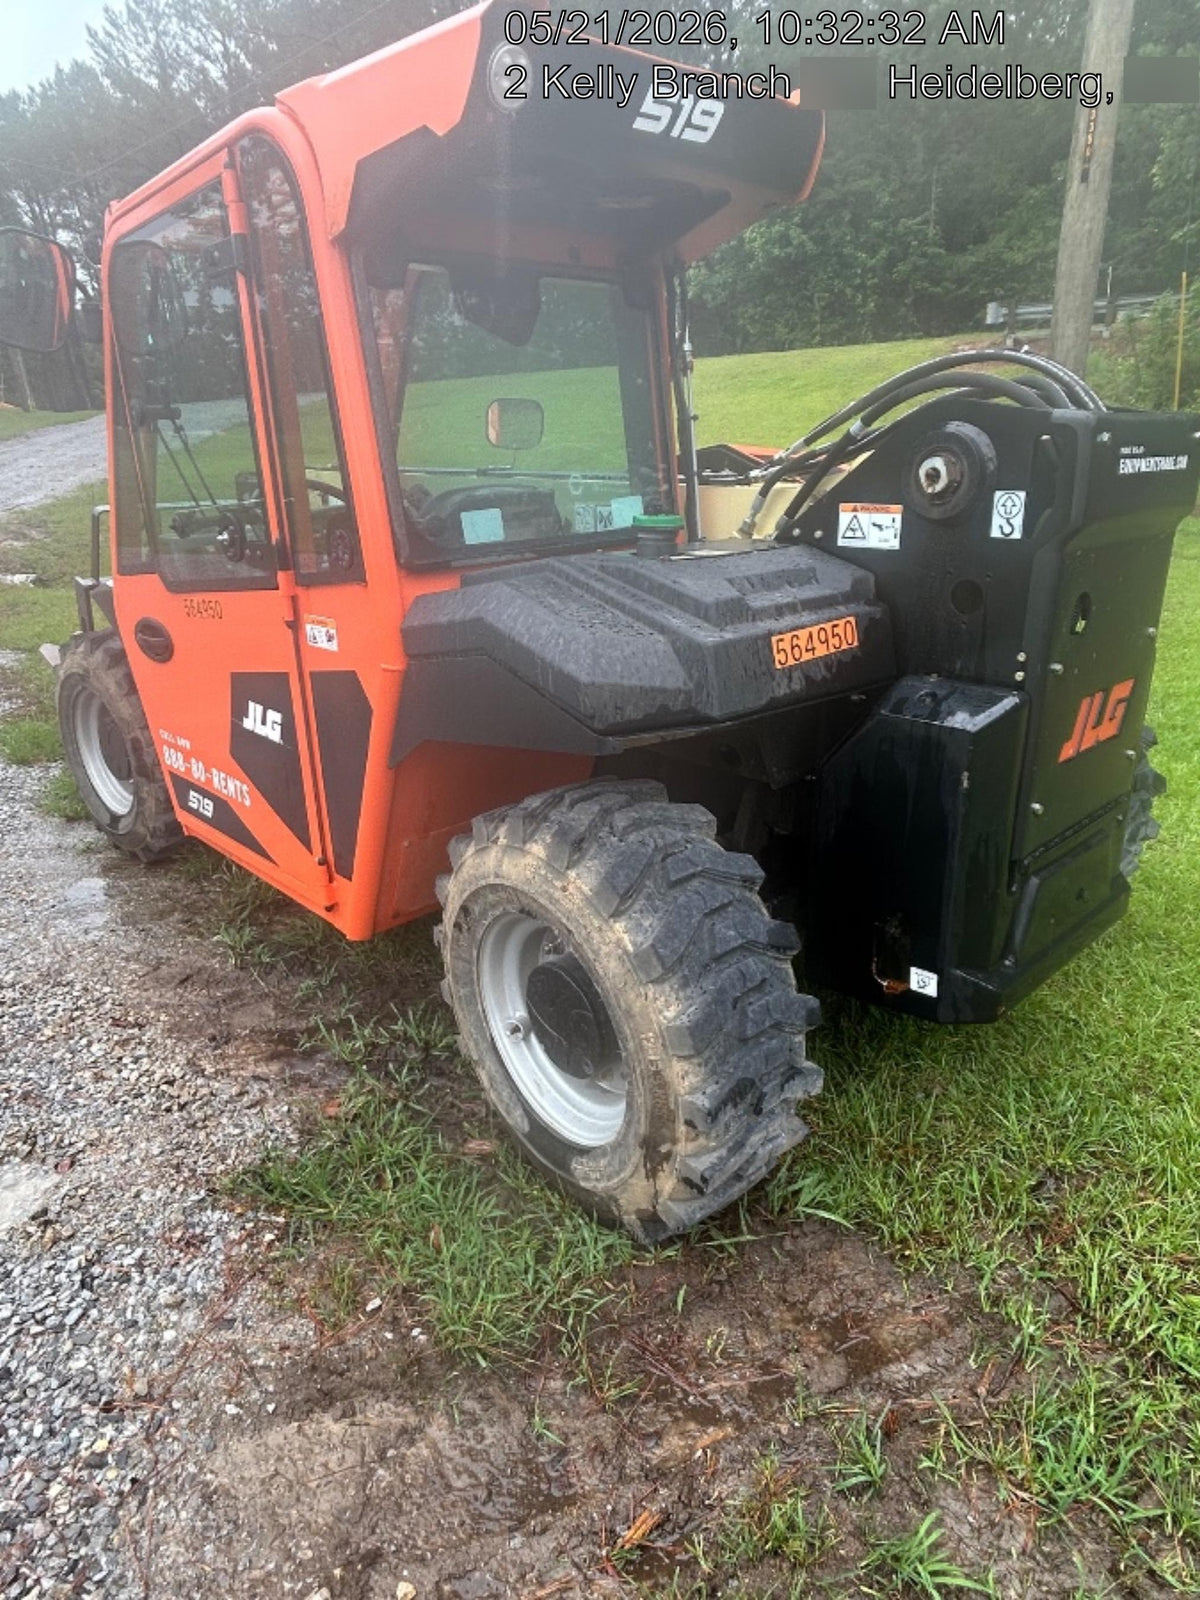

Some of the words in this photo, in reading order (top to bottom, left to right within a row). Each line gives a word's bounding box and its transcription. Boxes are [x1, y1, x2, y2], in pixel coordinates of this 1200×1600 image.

[632, 83, 725, 143] 519
[776, 620, 856, 666] 564950
[242, 700, 283, 745] JLG
[1058, 678, 1135, 763] JLG
[163, 745, 252, 808] 888-80-RENTS
[187, 789, 214, 818] 519
